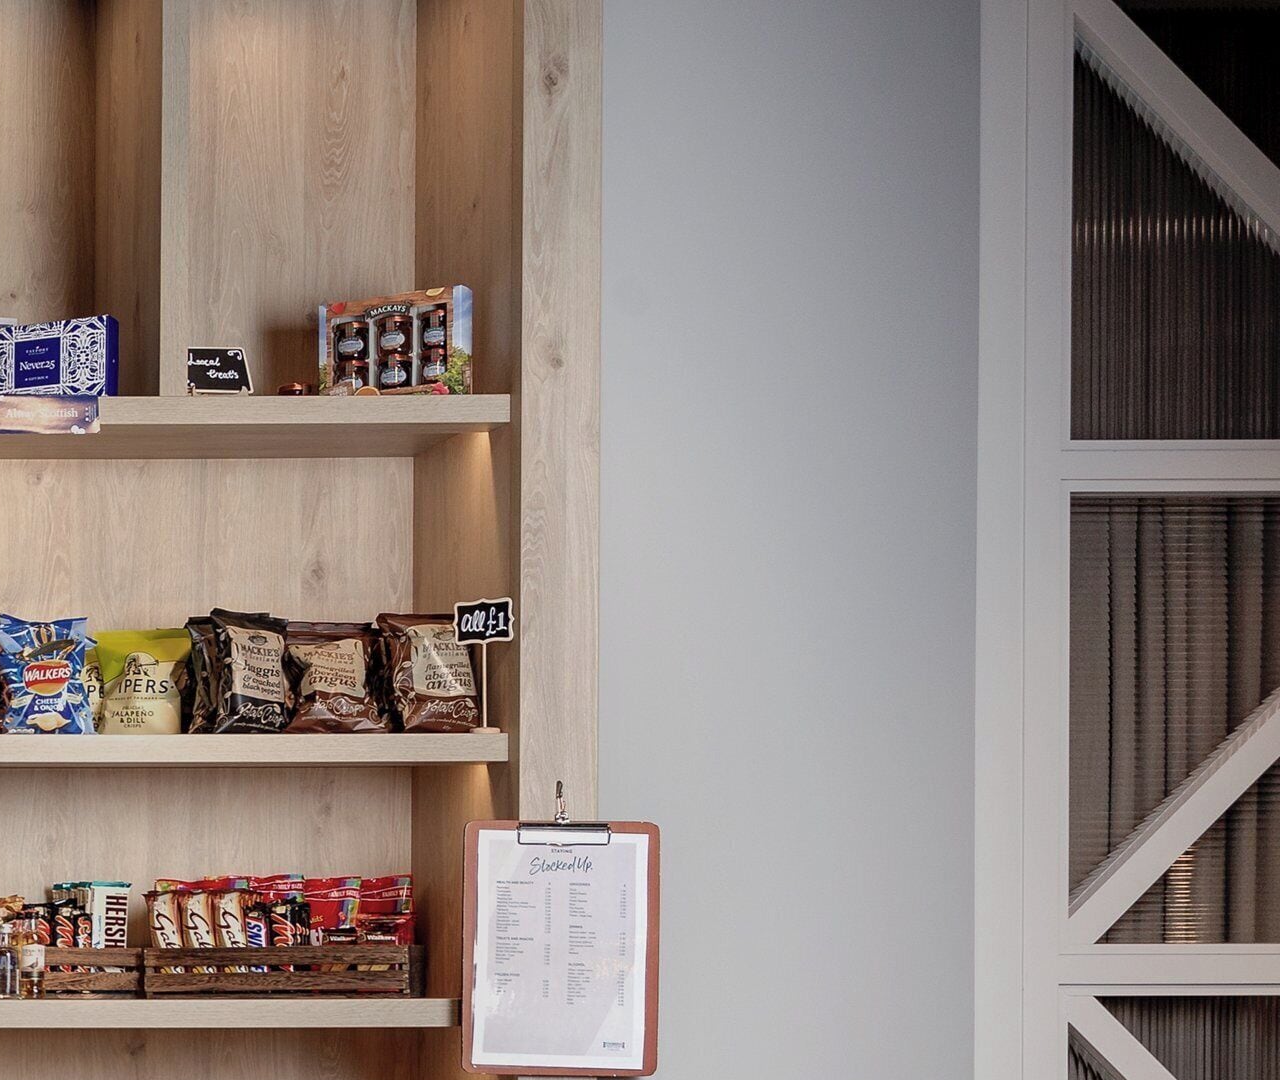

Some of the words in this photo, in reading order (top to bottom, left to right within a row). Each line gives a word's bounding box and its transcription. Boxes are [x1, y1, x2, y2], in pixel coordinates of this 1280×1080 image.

[370, 304, 407, 317] MACKAYS
[19, 360, 56, 371] Never25
[461, 608, 485, 632] all
[485, 606, 508, 636] £1
[23, 666, 73, 682] WALKERS
[243, 662, 281, 678] haggis
[308, 675, 357, 689] angus
[426, 677, 472, 690] angus
